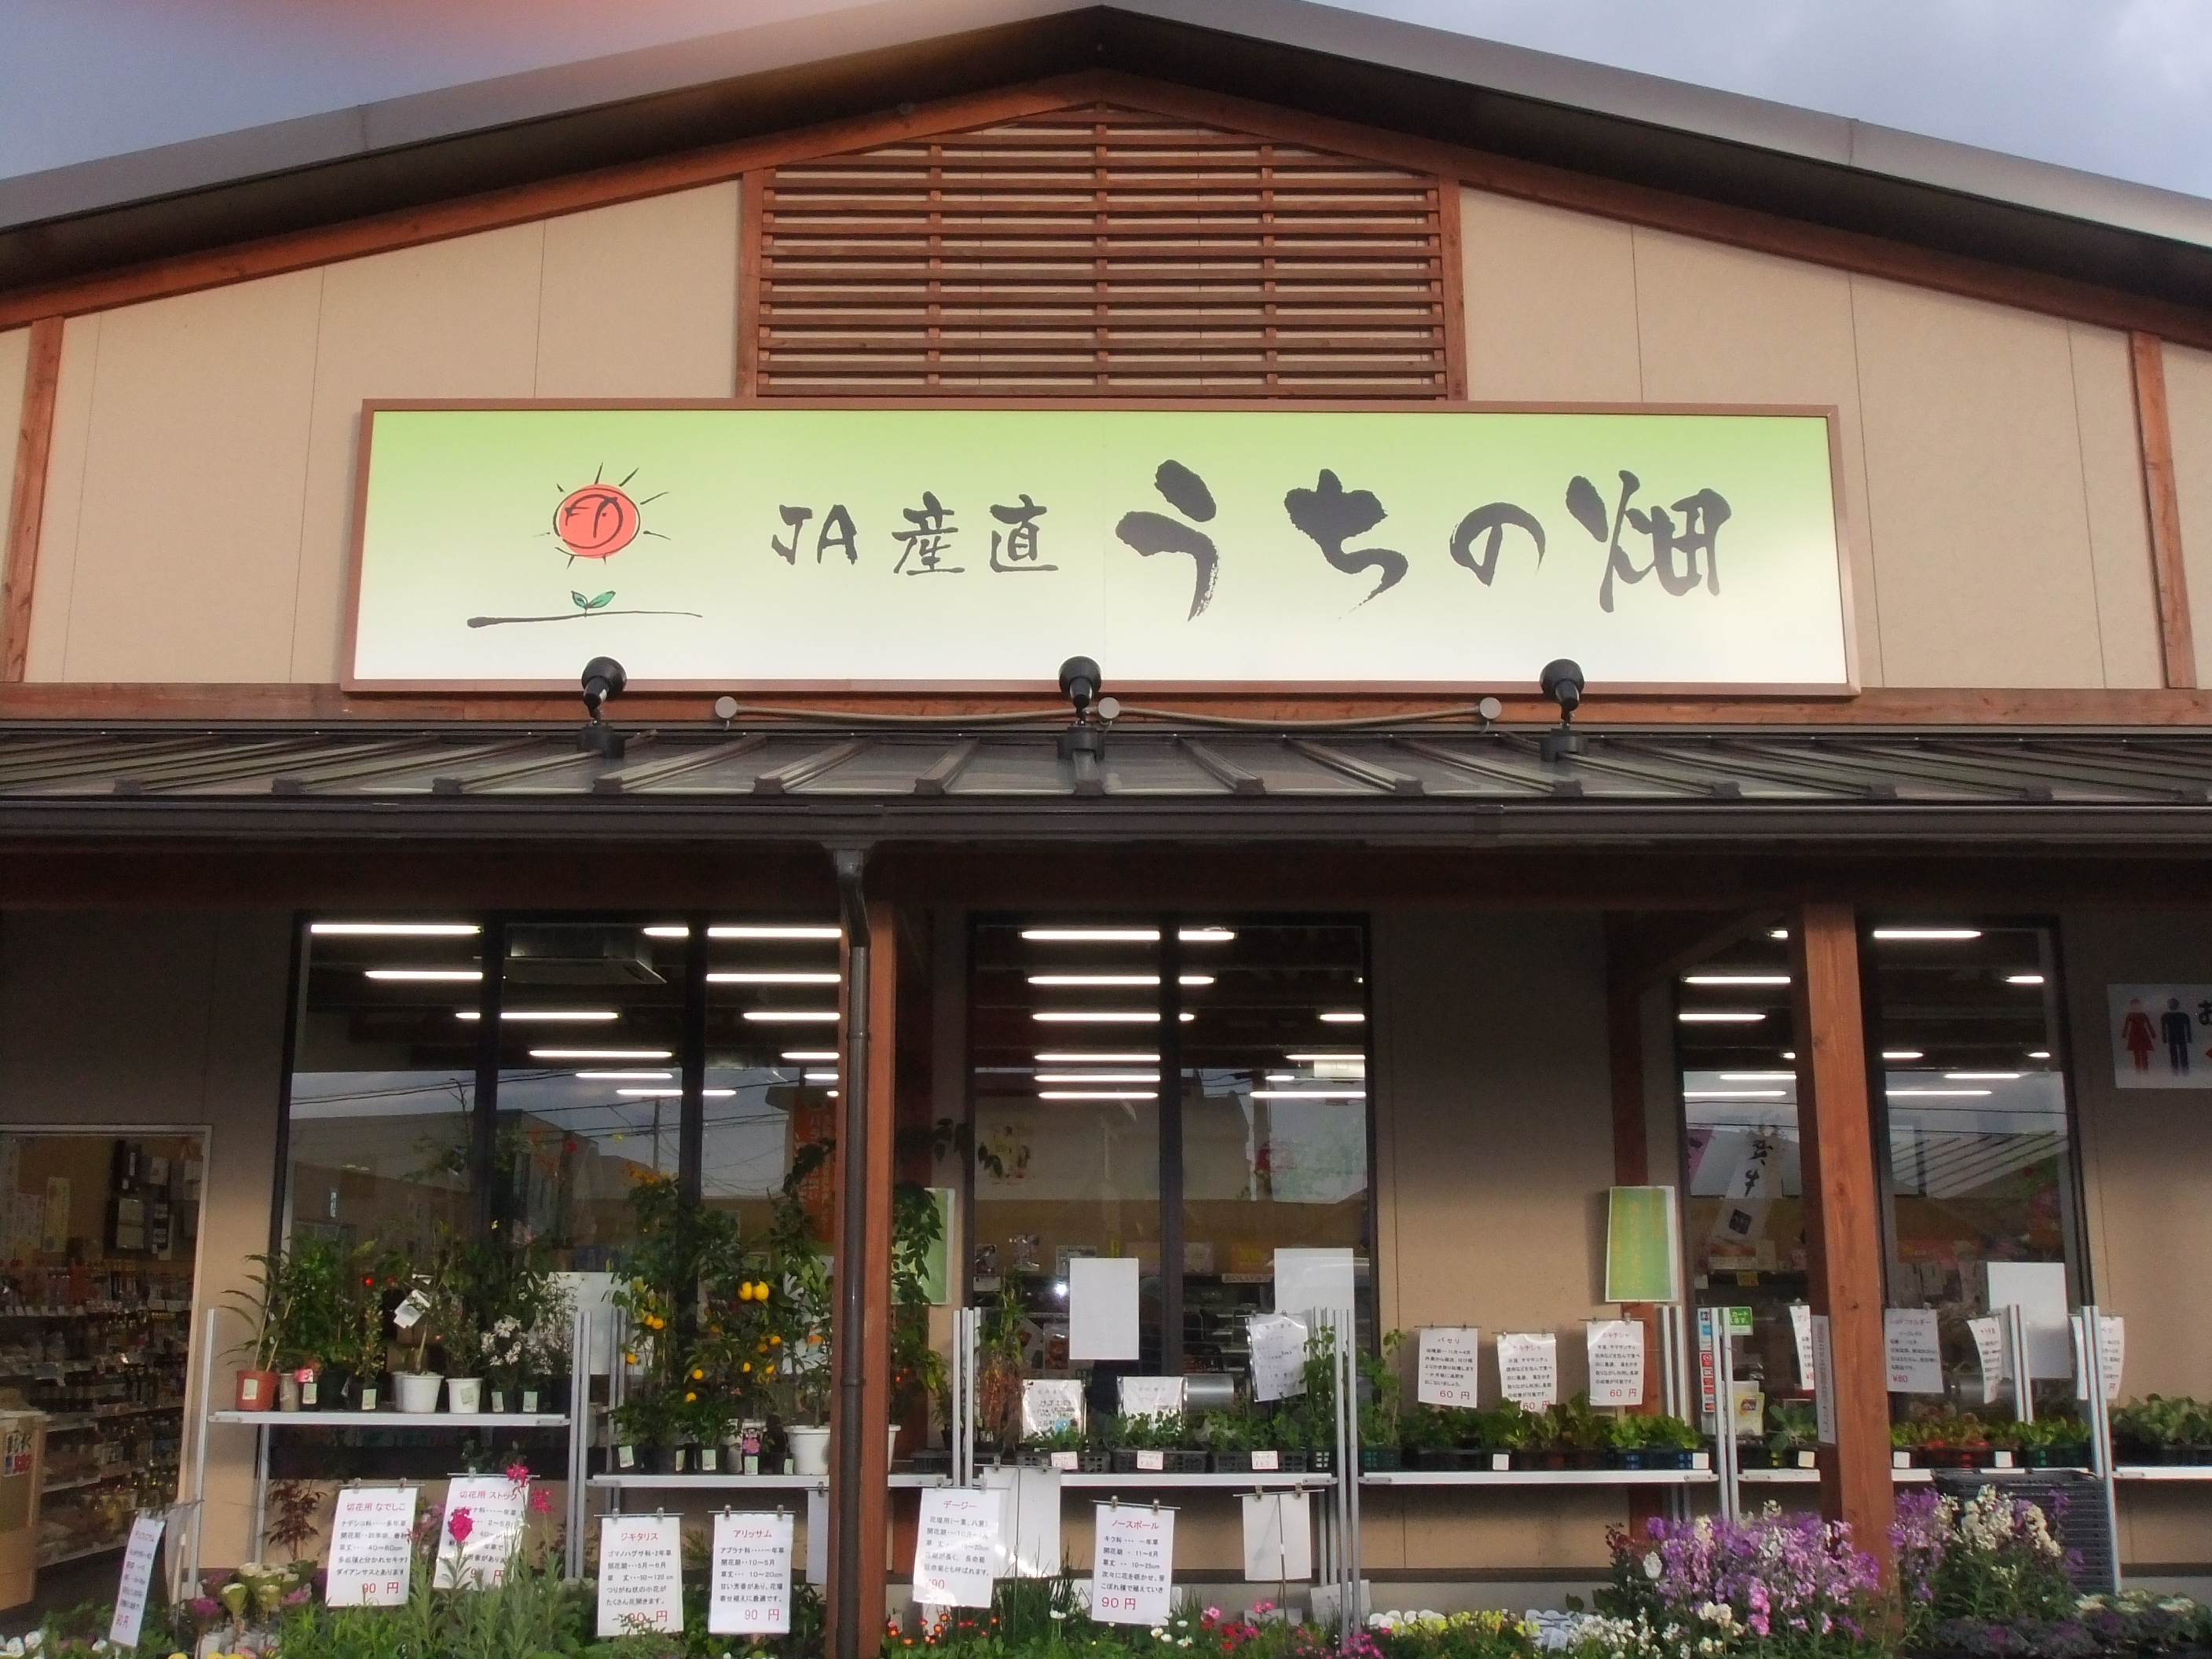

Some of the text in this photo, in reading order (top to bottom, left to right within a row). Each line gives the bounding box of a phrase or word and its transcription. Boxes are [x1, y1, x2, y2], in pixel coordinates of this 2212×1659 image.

[1115, 459, 1731, 621] うちの畑
[1440, 1390, 1470, 1400] 60 円
[1610, 1388, 1637, 1397] 60 円
[375, 1503, 406, 1511] なでしこ
[943, 1500, 977, 1510] デージー
[1111, 1519, 1159, 1529] ノースポール
[621, 1533, 659, 1541] ジキタリス
[733, 1529, 773, 1539] アリッサム
[386, 1581, 399, 1595] 円
[1101, 1596, 1137, 1611] 90 円
[655, 1610, 668, 1623] 円
[744, 1608, 780, 1621] 90 円
